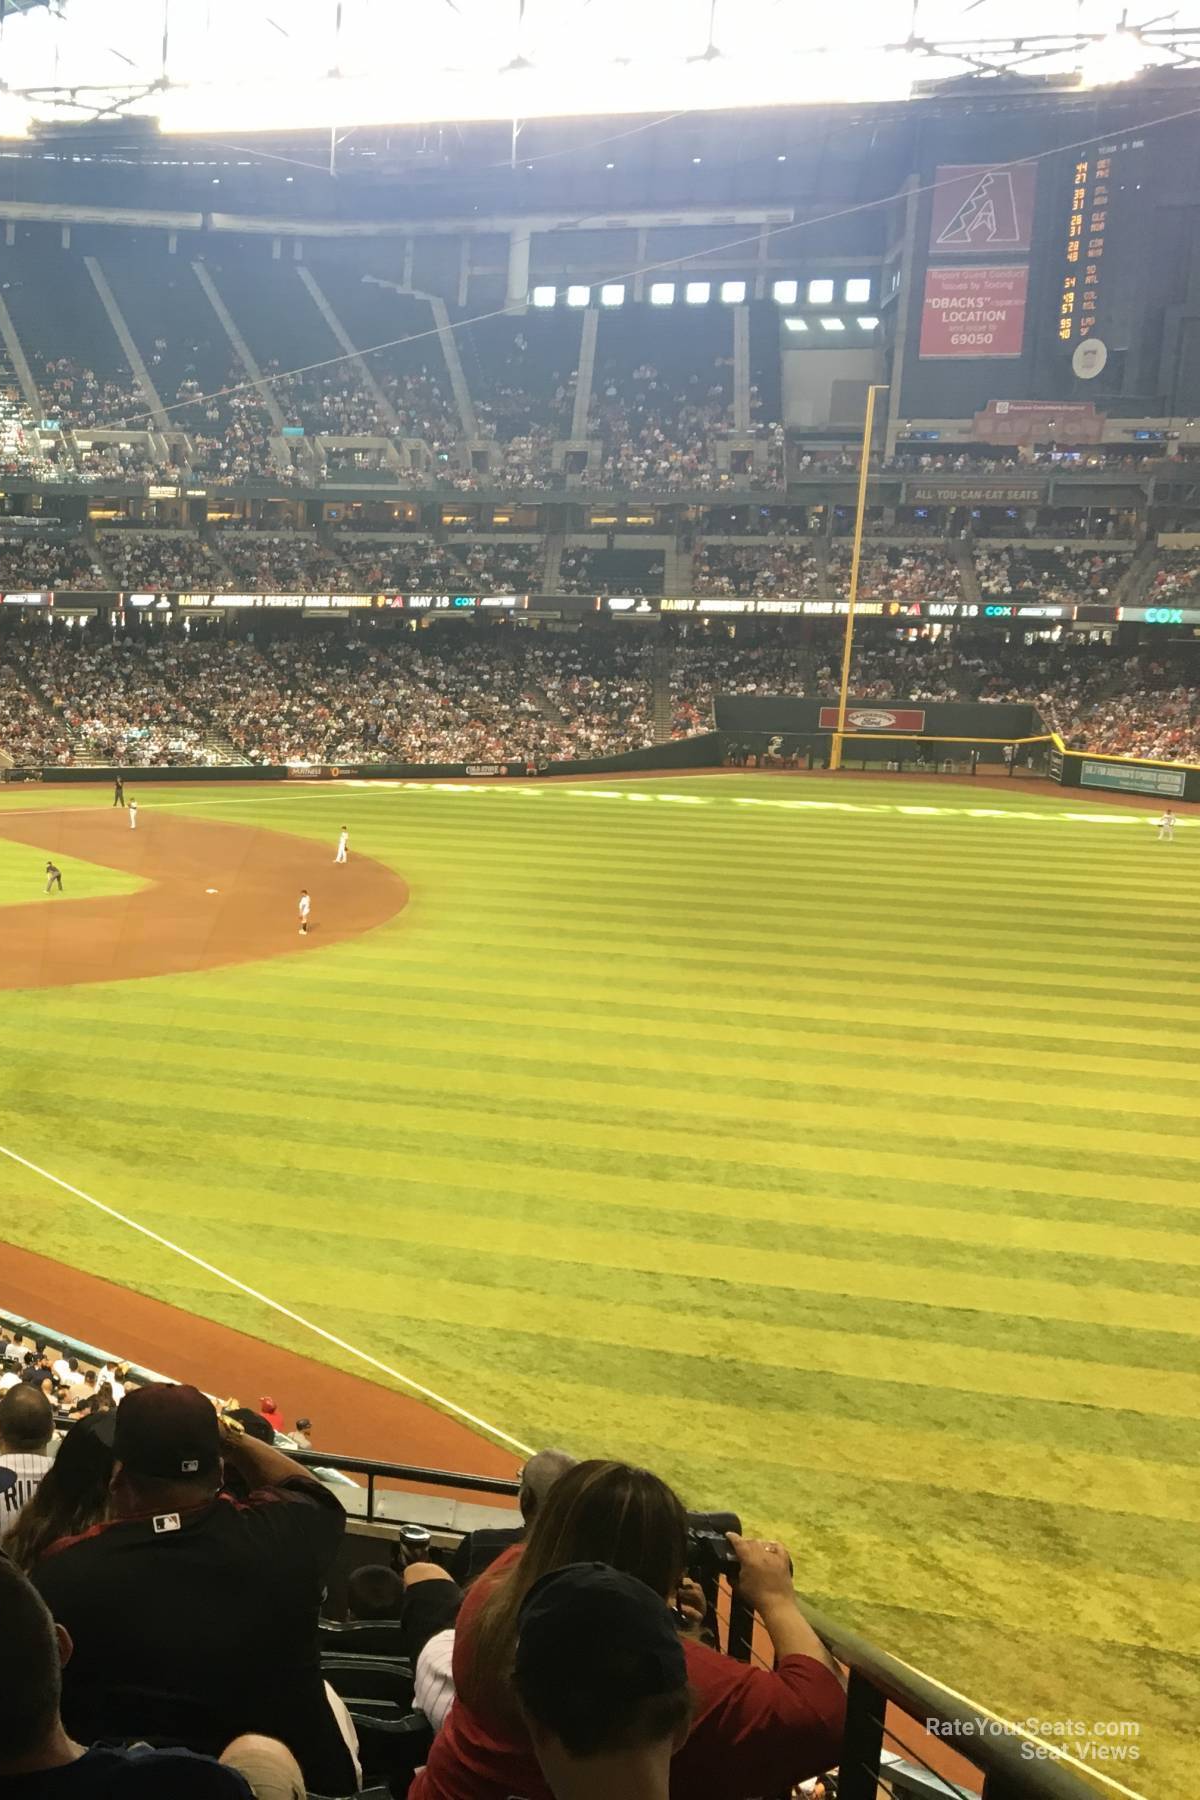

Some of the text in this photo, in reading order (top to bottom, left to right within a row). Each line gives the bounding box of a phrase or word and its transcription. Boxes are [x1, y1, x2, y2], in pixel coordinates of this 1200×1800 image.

[941, 310, 1006, 322] LOCATION
[951, 333, 993, 345] 69050
[915, 490, 1039, 500] ALL YOU-CAN-EAT SEATS
[178, 595, 209, 606] RANDY
[264, 596, 304, 607] PERFECT
[409, 597, 434, 608] MAY
[436, 597, 450, 608] 18
[455, 597, 476, 607] COX
[661, 600, 695, 611] RANDY
[756, 601, 801, 613] PERFECT
[835, 602, 883, 614] FIURINE
[929, 605, 956, 616] MAY
[961, 605, 978, 617] 18
[985, 606, 1011, 617] COX
[1144, 608, 1183, 623] COX
